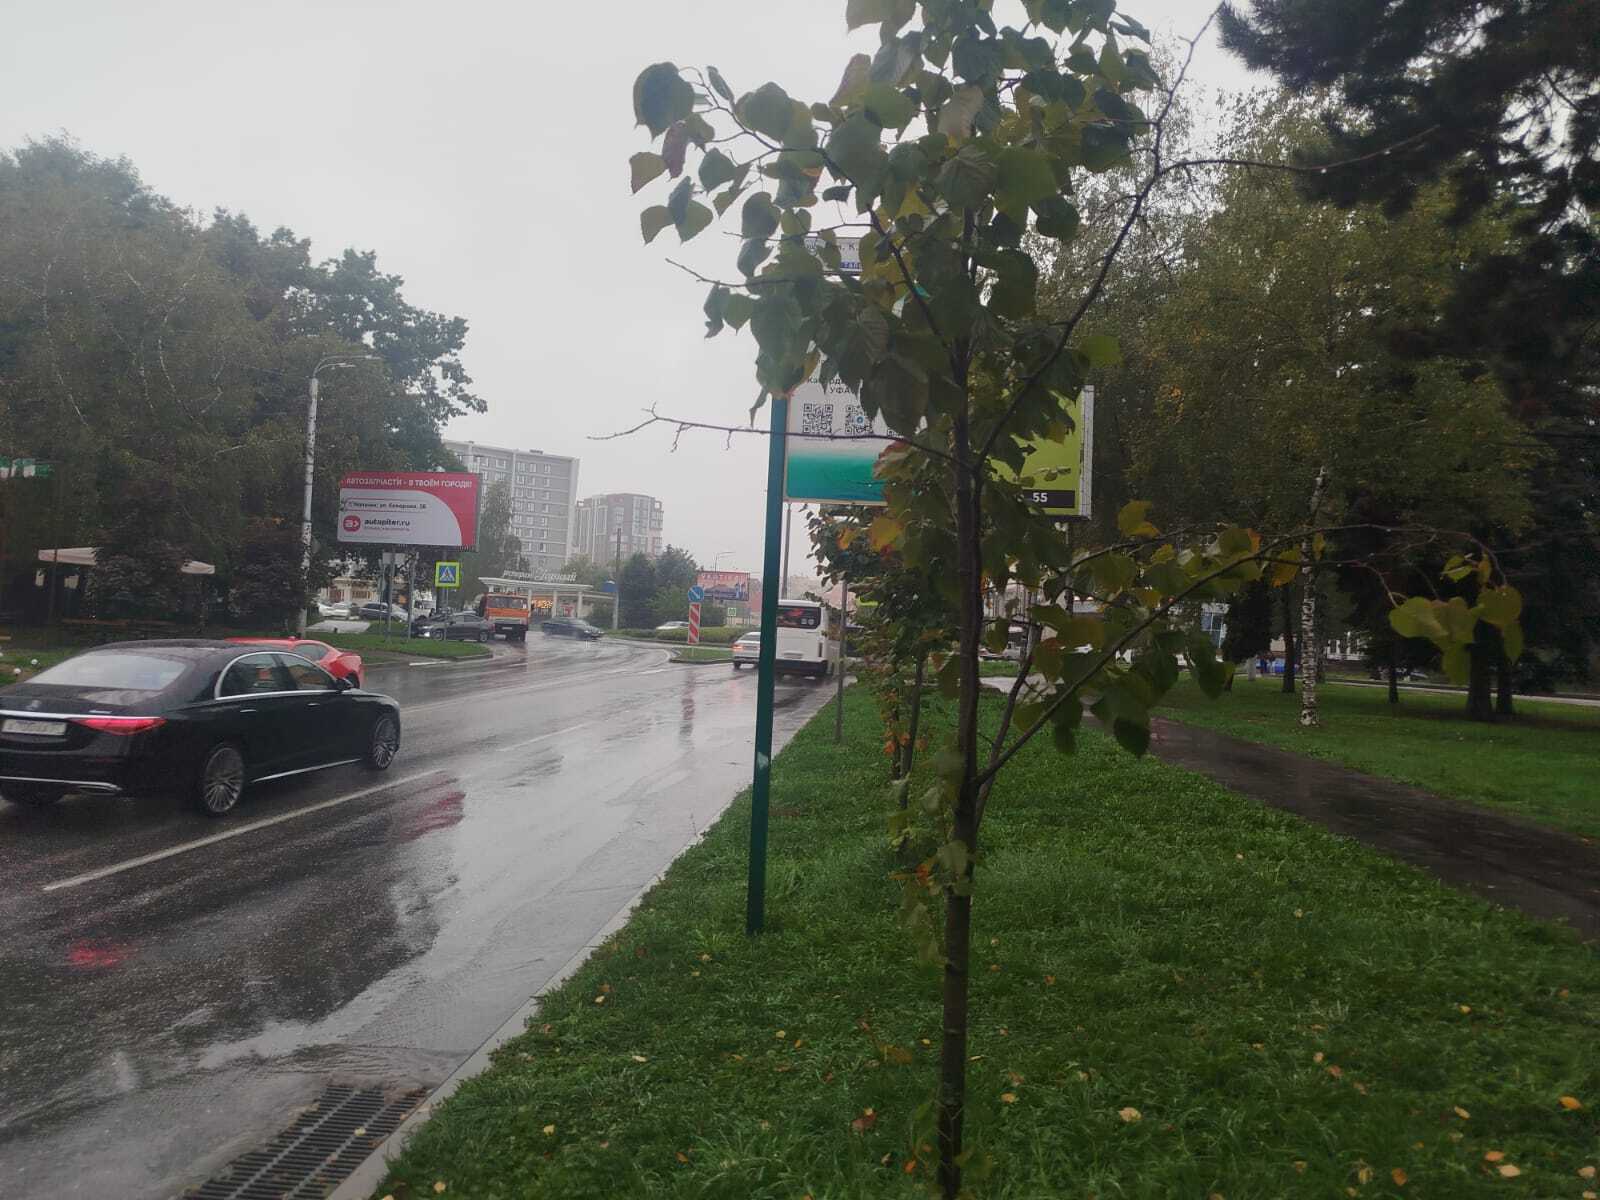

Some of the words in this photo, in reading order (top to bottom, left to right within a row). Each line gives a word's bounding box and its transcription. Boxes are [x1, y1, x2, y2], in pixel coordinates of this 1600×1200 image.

[416, 478, 440, 488] ТВОЁМ
[1032, 492, 1048, 503] 55
[364, 519, 411, 527] autopiter.ru
